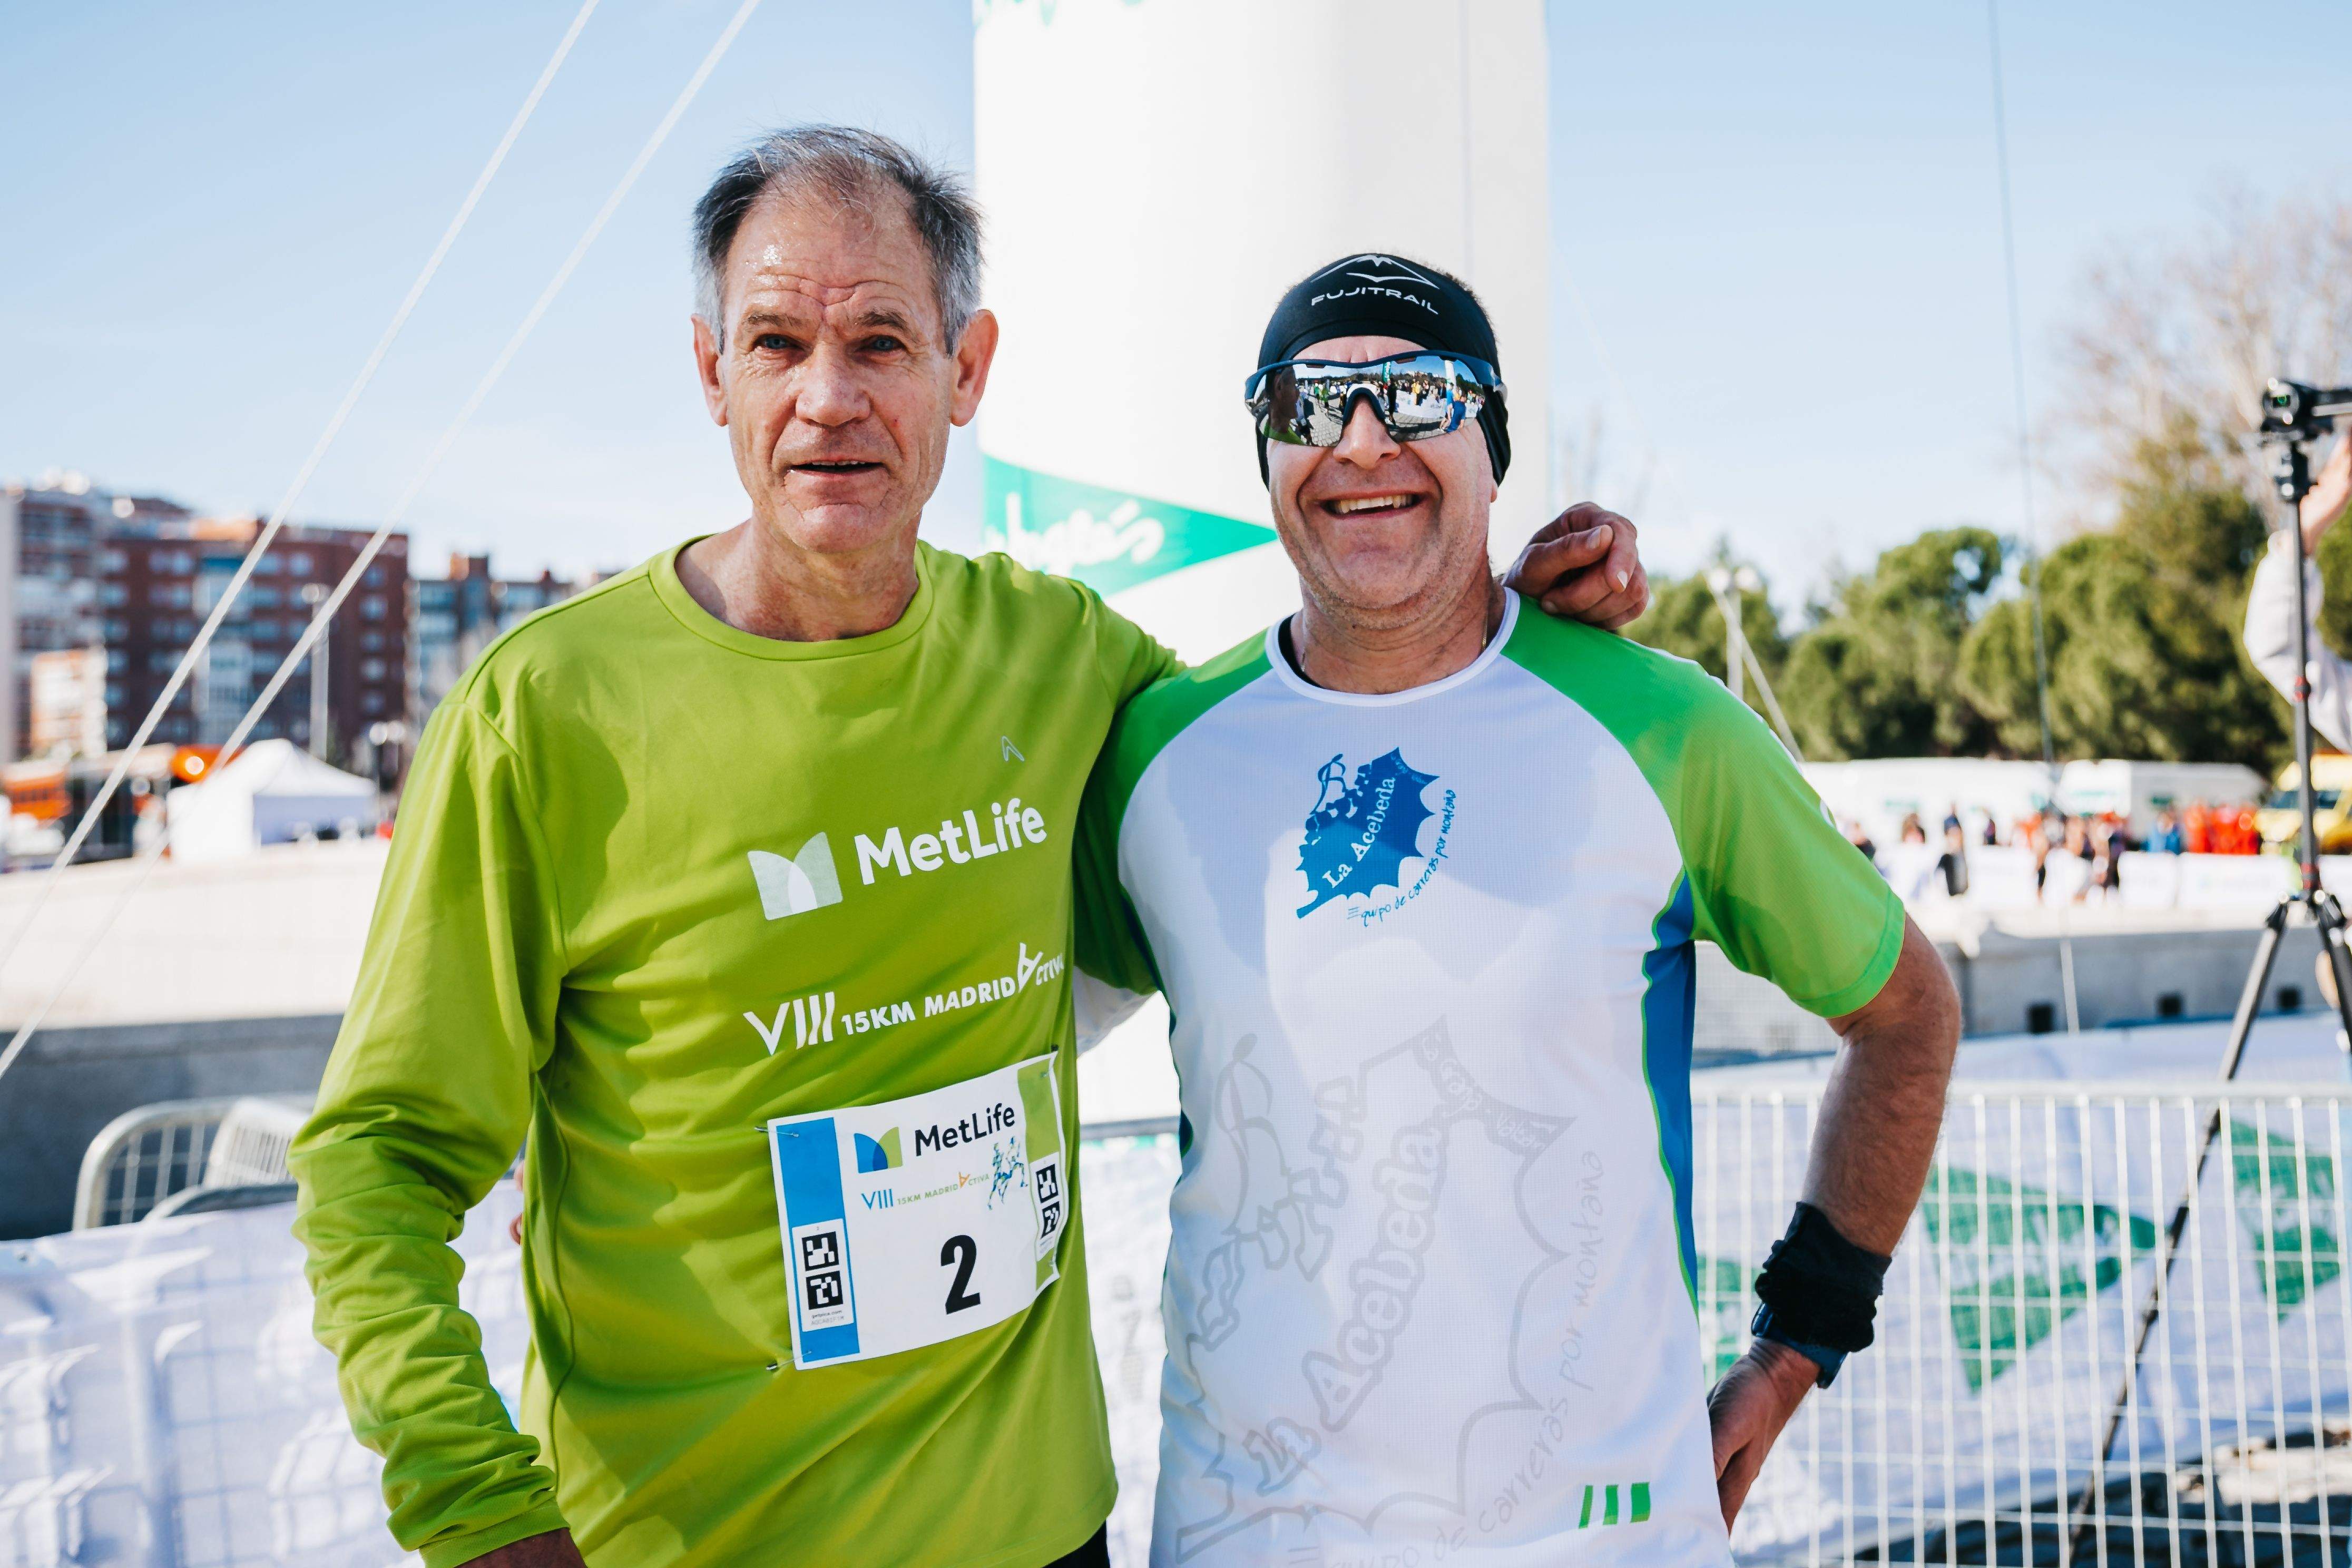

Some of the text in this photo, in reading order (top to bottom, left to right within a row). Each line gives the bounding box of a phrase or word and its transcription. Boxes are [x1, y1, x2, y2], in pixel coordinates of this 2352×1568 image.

[1311, 287, 1438, 315] FUJITRAIL
[854, 798, 1047, 885] MetLife
[1322, 777, 1396, 888] La Acebeda
[1347, 904, 1391, 927] Equipo
[1395, 896, 1406, 909] de
[1408, 857, 1438, 899] carreras
[1435, 836, 1448, 859] por
[742, 991, 835, 1056] VIII
[841, 1001, 916, 1035] 15KM
[925, 977, 1015, 1018] MADRID
[915, 1103, 1015, 1156] MetLife
[861, 1188, 894, 1210] VIII
[897, 1194, 921, 1205] 15KM
[924, 1183, 958, 1199] MADRID
[1570, 1150, 1604, 1308] montaña
[940, 1234, 981, 1315] 2
[1242, 1123, 1448, 1496] La Acebeda
[1559, 1318, 1594, 1391] por
[1478, 1397, 1568, 1533] carreras
[1434, 1526, 1468, 1561] de
